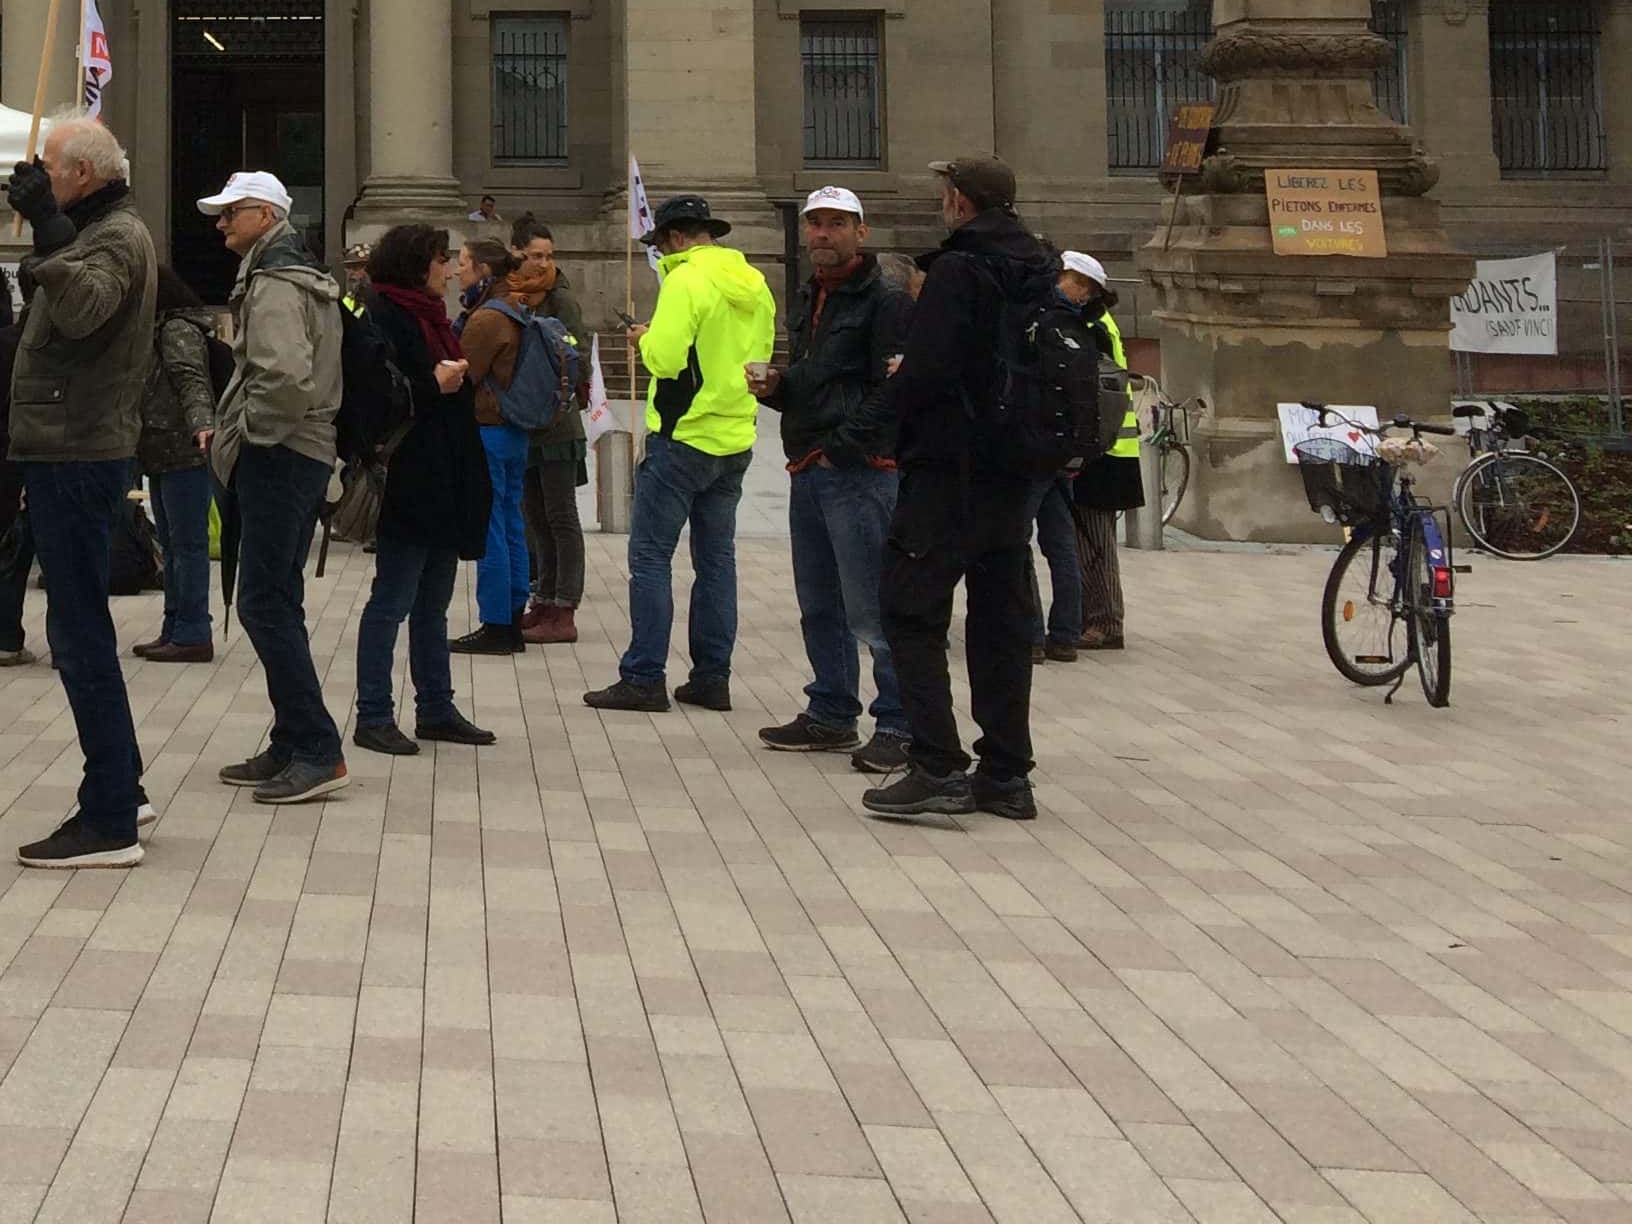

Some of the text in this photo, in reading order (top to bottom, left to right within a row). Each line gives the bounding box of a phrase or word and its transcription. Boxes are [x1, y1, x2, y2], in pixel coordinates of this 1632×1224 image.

[1338, 178, 1367, 192] LES
[1272, 198, 1322, 212] PIETONS
[1301, 218, 1334, 232] DANS
[1339, 220, 1364, 235] LES
